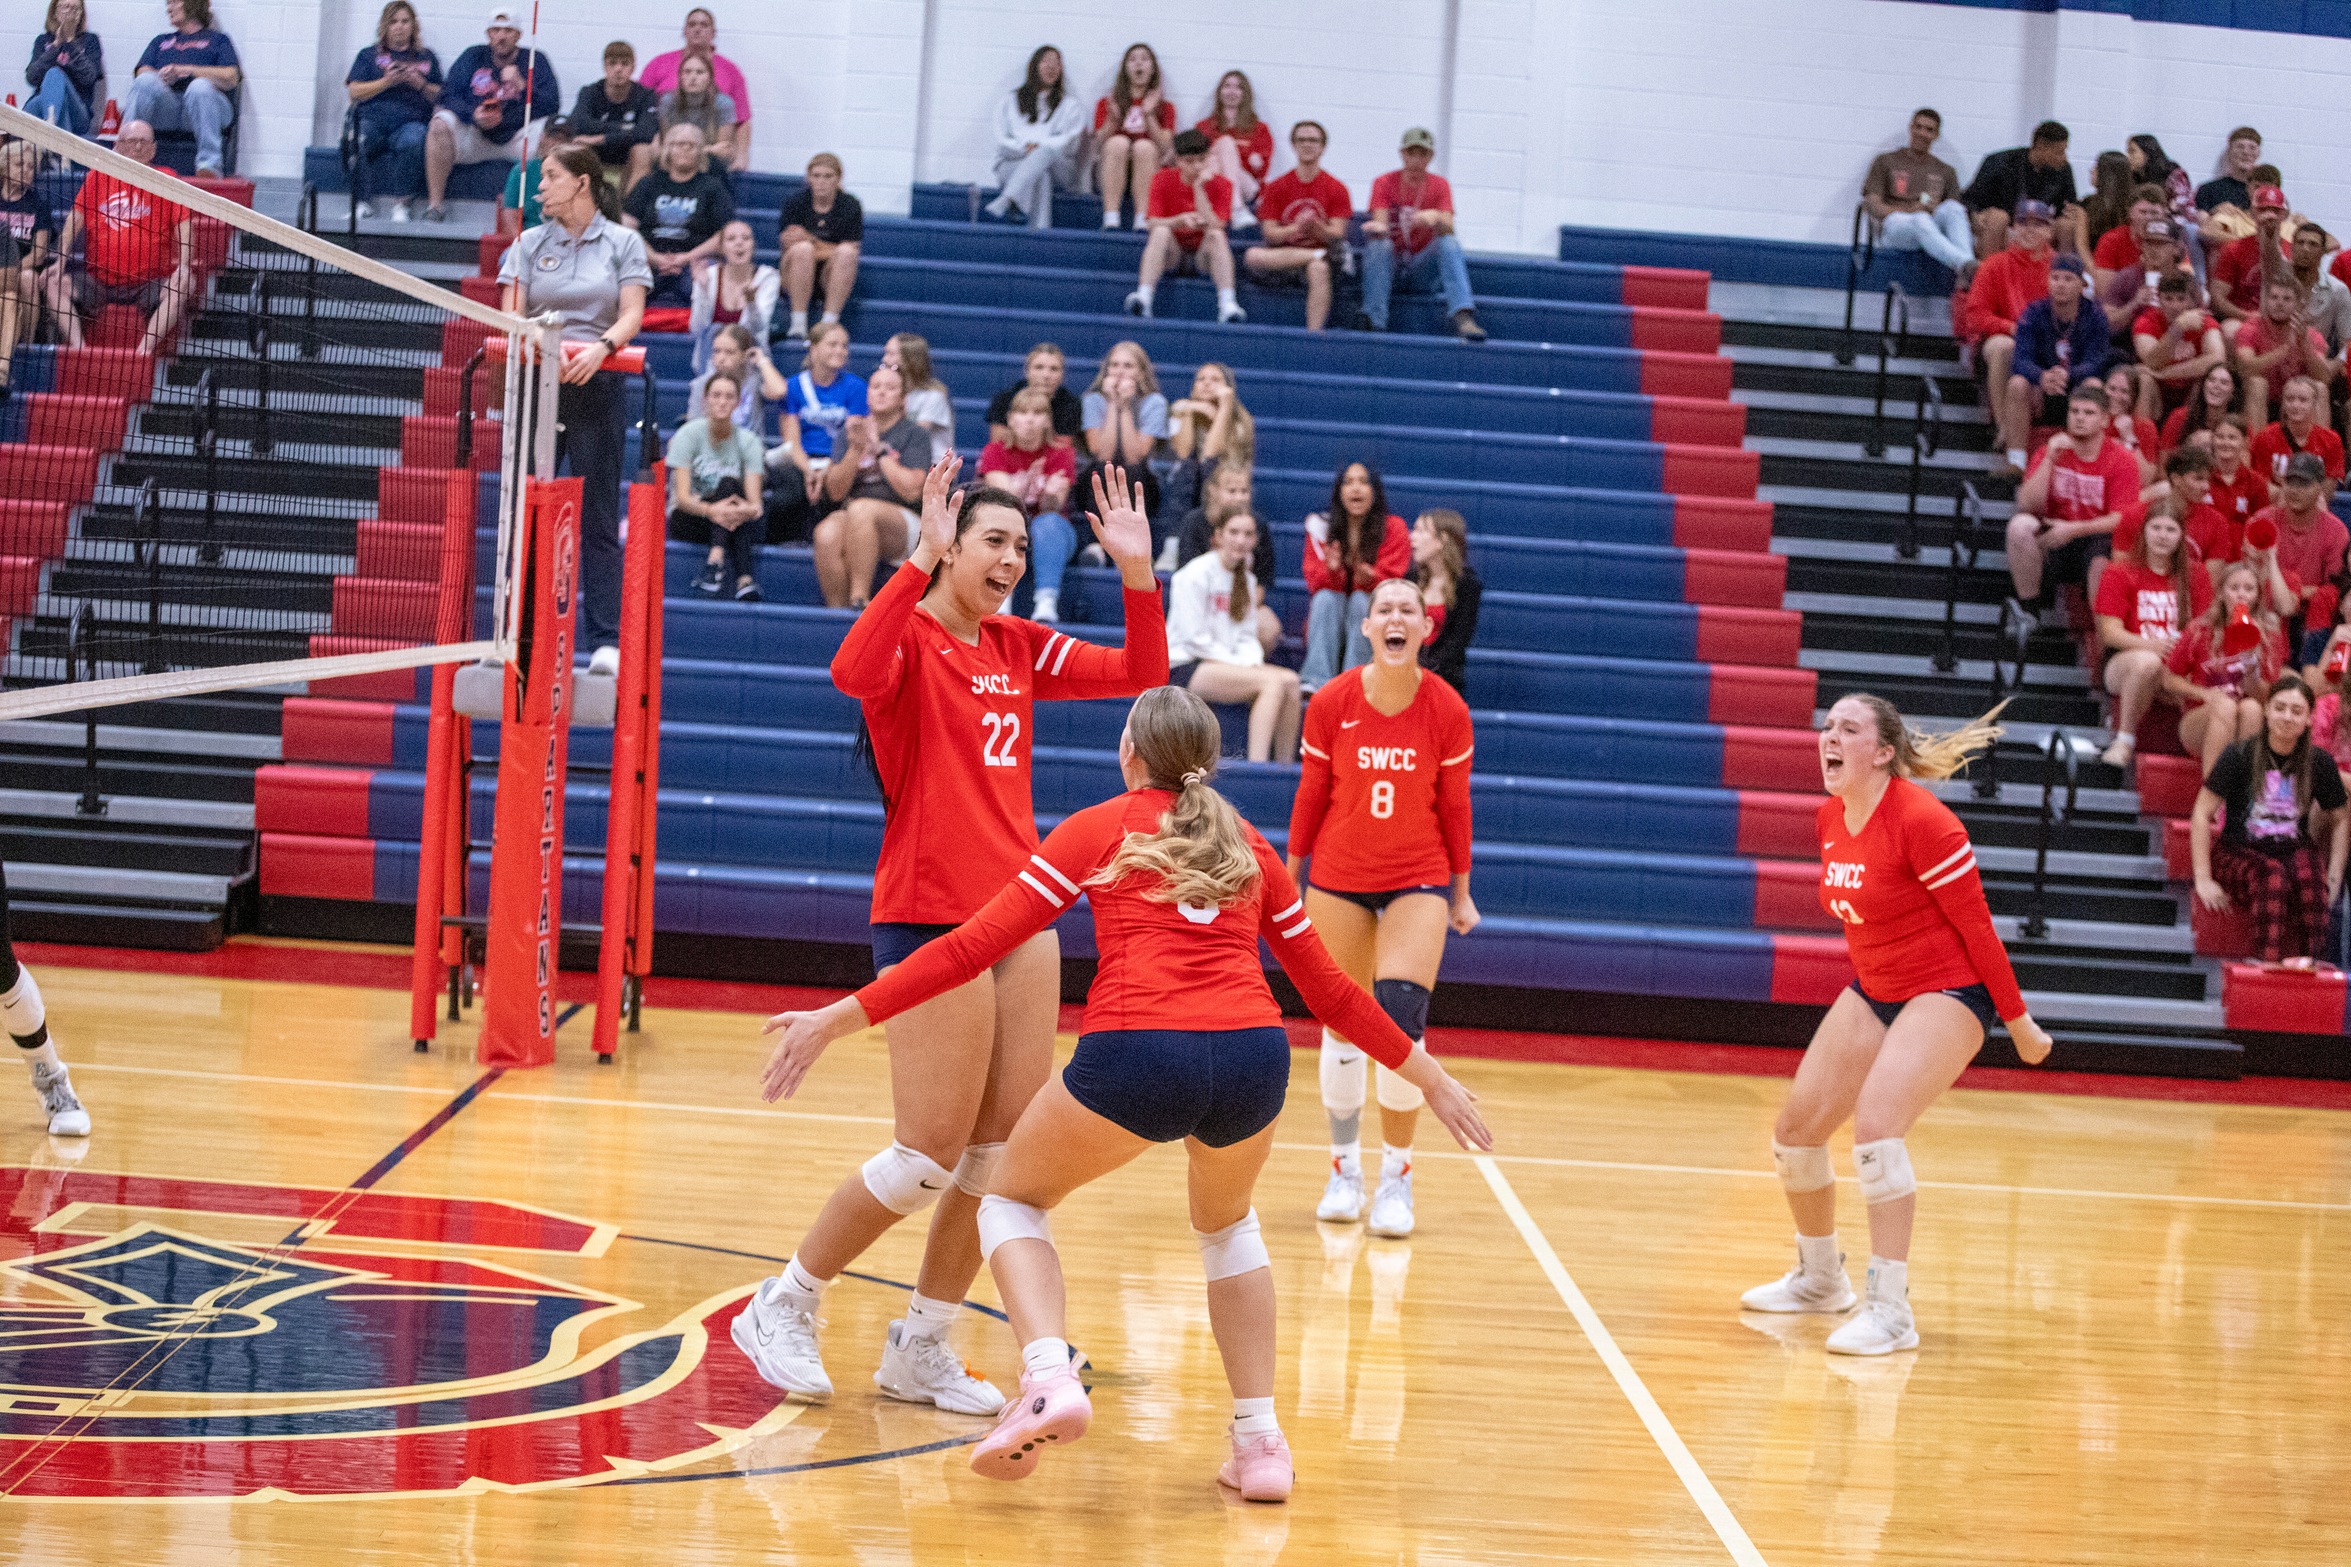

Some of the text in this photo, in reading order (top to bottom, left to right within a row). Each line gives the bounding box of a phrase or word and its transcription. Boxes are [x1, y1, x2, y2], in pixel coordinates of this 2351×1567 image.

[981, 711, 1020, 767] 22
[1357, 745, 1417, 772] SWCC
[1370, 780, 1395, 819] 8
[1824, 861, 1866, 889] SWCC
